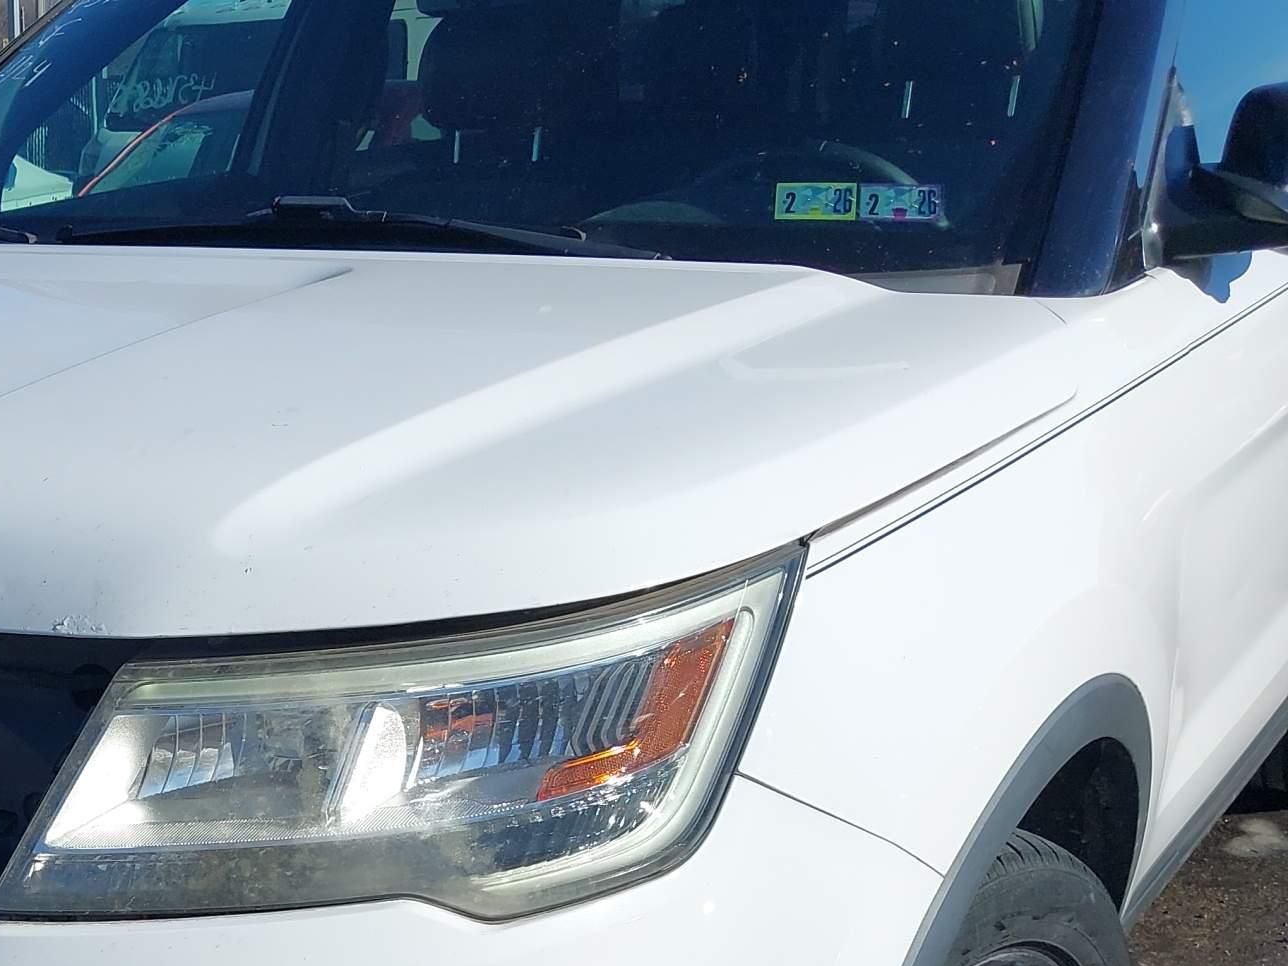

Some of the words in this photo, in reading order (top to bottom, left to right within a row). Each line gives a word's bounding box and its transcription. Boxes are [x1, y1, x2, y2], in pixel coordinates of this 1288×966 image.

[785, 191, 796, 213] 2
[833, 188, 853, 215] 26
[868, 193, 880, 215] 2
[917, 189, 937, 215] 26
